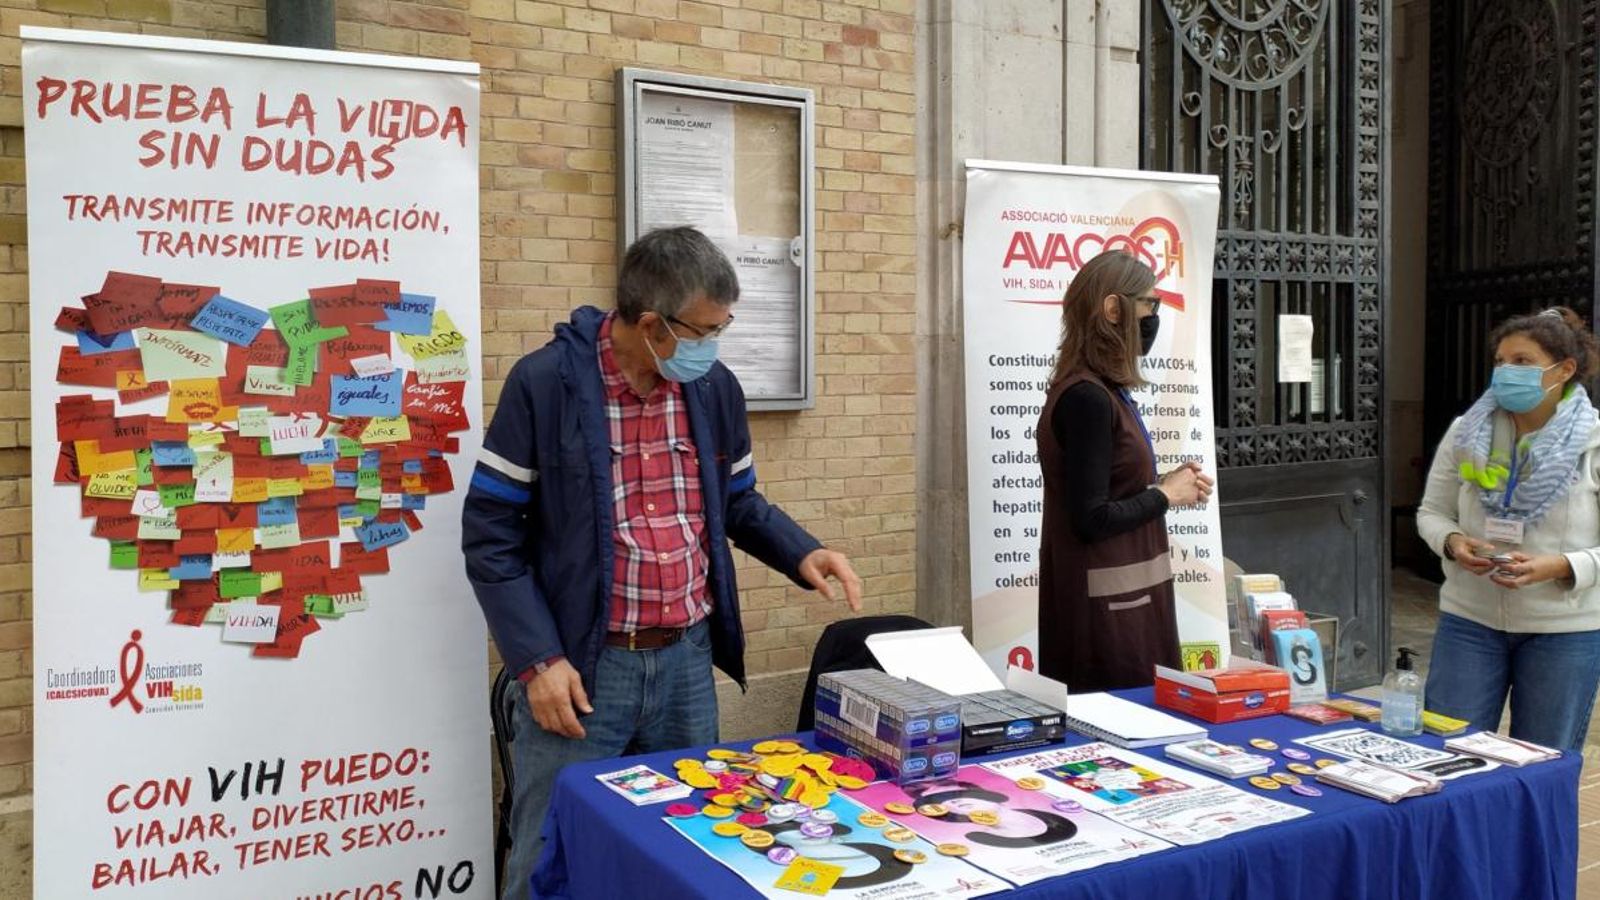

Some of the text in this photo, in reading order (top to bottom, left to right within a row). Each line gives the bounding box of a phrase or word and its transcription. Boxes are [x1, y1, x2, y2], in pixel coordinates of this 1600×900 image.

[36, 76, 233, 131] PRUEBA
[256, 92, 317, 135] LA
[646, 116, 666, 125] JOAN
[687, 120, 712, 129] CANUT
[138, 130, 400, 182] SIN DUDAS
[63, 194, 450, 235] TRANSMITE INFORMACIÓN,
[1001, 210, 1136, 227] ASSOCIACIÓ VALENCIANA
[137, 230, 391, 263] TRANSMITE VIDA!
[1003, 278, 1027, 290] VIH,
[1029, 279, 1054, 290] SIDA
[989, 353, 1198, 374] Constituid AVACOS-H,
[989, 381, 1033, 391] somos
[1151, 383, 1199, 396] personas
[990, 403, 1201, 419] compro defensa de
[991, 426, 1011, 440] los
[1149, 429, 1180, 443] ejora
[1190, 427, 1203, 441] de
[992, 474, 1043, 489] afectad
[992, 499, 1042, 516] hepatit
[993, 524, 1209, 538] en su stencia
[994, 550, 1031, 563] entre
[1181, 548, 1188, 561] y
[1194, 545, 1210, 558] los
[995, 569, 1212, 588] colecti rables.
[47, 661, 203, 689] Coordinadora Asociaciones
[107, 747, 431, 815] CON VIH PUEDO:
[114, 785, 426, 850] VIAJAR, DIVERTIRME,
[91, 819, 447, 890] BAILAR, TENER SEXO...
[414, 860, 475, 900] NO
